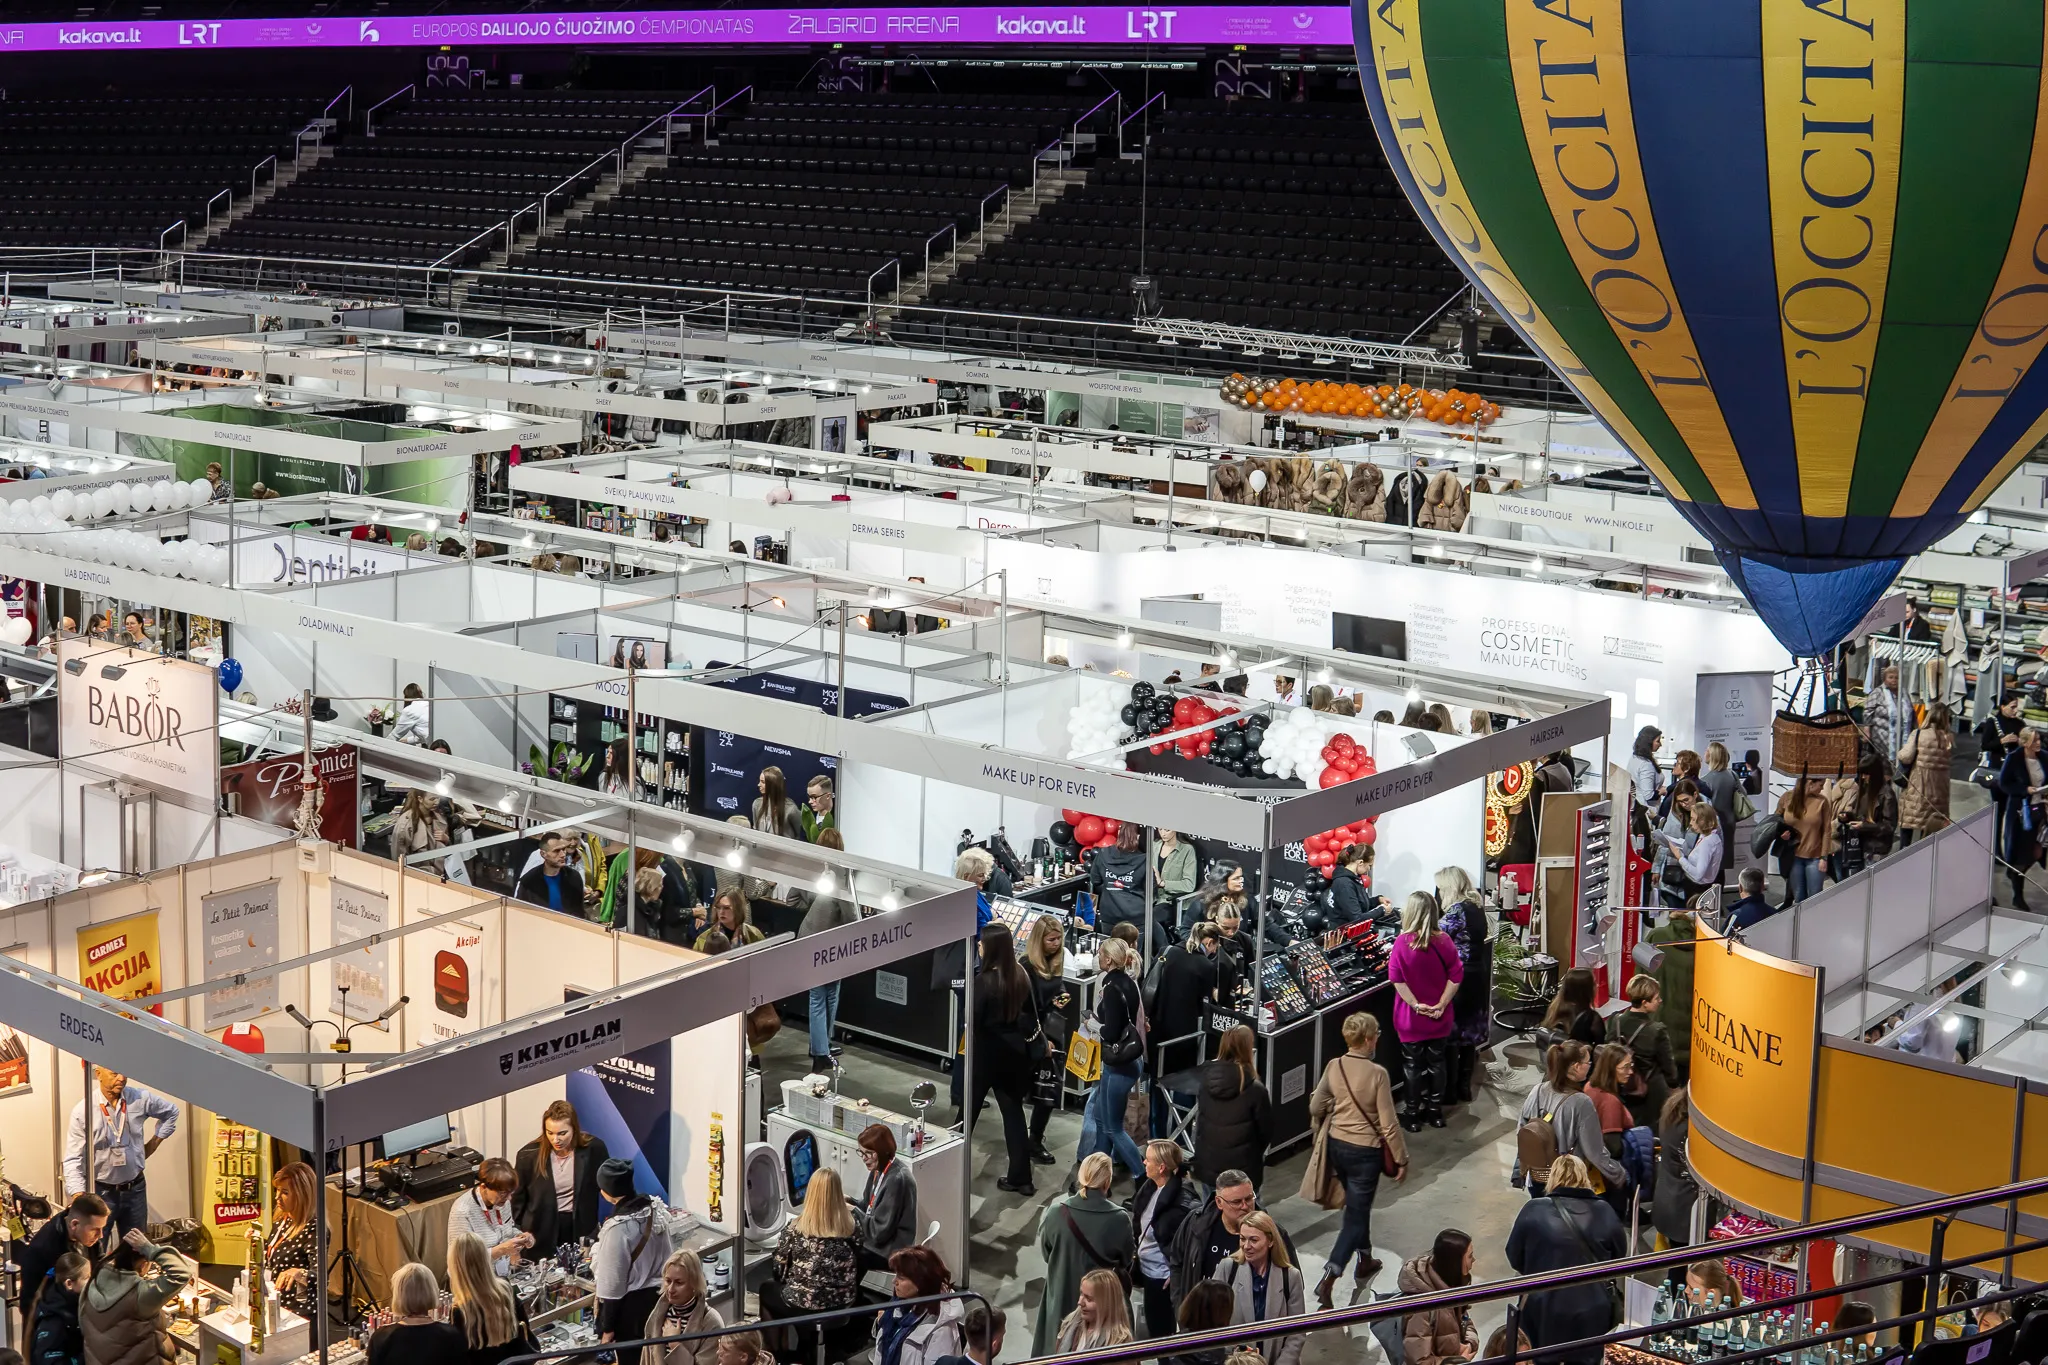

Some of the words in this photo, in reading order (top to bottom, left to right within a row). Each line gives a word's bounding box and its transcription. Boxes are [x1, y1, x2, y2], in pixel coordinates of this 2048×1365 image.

[178, 23, 223, 45] LRT
[412, 23, 479, 38] EUROPOS
[481, 21, 551, 37] DAILIOJO
[554, 16, 636, 36] ČIUOŽIMO
[638, 17, 755, 36] ČEMPIONATAS
[887, 16, 960, 34] ARENA
[996, 15, 1087, 35] kakava.lt
[1126, 11, 1177, 39] LRT
[58, 28, 142, 45] kakava.lt
[344, 369, 356, 377] DECO
[965, 371, 990, 380] SOMINTA
[1088, 382, 1121, 392] WOLFSTONE
[1122, 386, 1143, 394] JEWELS
[595, 398, 612, 407] SHERY
[760, 406, 777, 415] SHERY
[214, 430, 252, 444] BIONATUROAZE
[518, 432, 541, 442] CELEMI
[396, 442, 448, 456] BIONATUROAZE
[1011, 447, 1031, 457] TOKIA
[604, 486, 628, 499] SVEIKŲ
[628, 489, 654, 503] PLAUKŲ
[1498, 503, 1529, 517] NIKOLE
[1530, 508, 1573, 523] BOUTIQUE
[1583, 514, 1655, 533] WWW.NIKOLE.LT
[852, 523, 879, 537] DERMA
[880, 526, 906, 540] SERIES
[64, 567, 78, 579] UAB
[78, 569, 111, 586] DENTICIJA
[297, 616, 355, 638] JOLADMINA.LT
[1481, 616, 1572, 640] PROFESSIONAL
[1480, 629, 1576, 662] COSMETIC
[1480, 649, 1589, 683] MANUFACTURERS
[1724, 700, 1745, 710] ODA
[1529, 725, 1565, 746] HAIRSERA
[764, 744, 792, 757] NEWSHA
[129, 751, 154, 766] VOKIŠKA
[154, 757, 187, 775] KOSMETIKA
[328, 773, 355, 784] Premier
[982, 763, 1018, 785] MAKE
[1020, 771, 1037, 787] UP
[1038, 776, 1064, 792] FOR
[1066, 780, 1097, 800] EVER
[1354, 789, 1381, 807] MAKE
[1381, 785, 1398, 800] UP
[1399, 779, 1414, 794] FOR
[1414, 771, 1434, 789] EVER
[1284, 842, 1305, 852] MAK
[210, 911, 222, 925] Le
[222, 903, 241, 921] Petit
[243, 901, 271, 918] Prince
[336, 898, 344, 912] Le
[345, 900, 358, 916] Petit
[360, 905, 381, 923] Prince
[210, 928, 245, 946] Kosmetika
[455, 934, 481, 949] Akcija!
[813, 936, 868, 969] PREMIER
[871, 921, 913, 950] BALTIC
[89, 936, 126, 961] CARMEX
[214, 944, 242, 960] vaikams
[84, 950, 152, 994] AKCIJA
[1212, 1012, 1232, 1024] MAKE
[59, 1012, 105, 1047] ERDESA
[517, 1017, 621, 1064] KRYOLAN
[517, 1048, 580, 1072] PROFESSIONAL
[584, 1034, 621, 1050] MAKE-UP
[1039, 1069, 1052, 1080] 89
[608, 1076, 617, 1084] IS
[626, 1080, 655, 1095] SCIENCE
[217, 1204, 260, 1218] CARMEX
